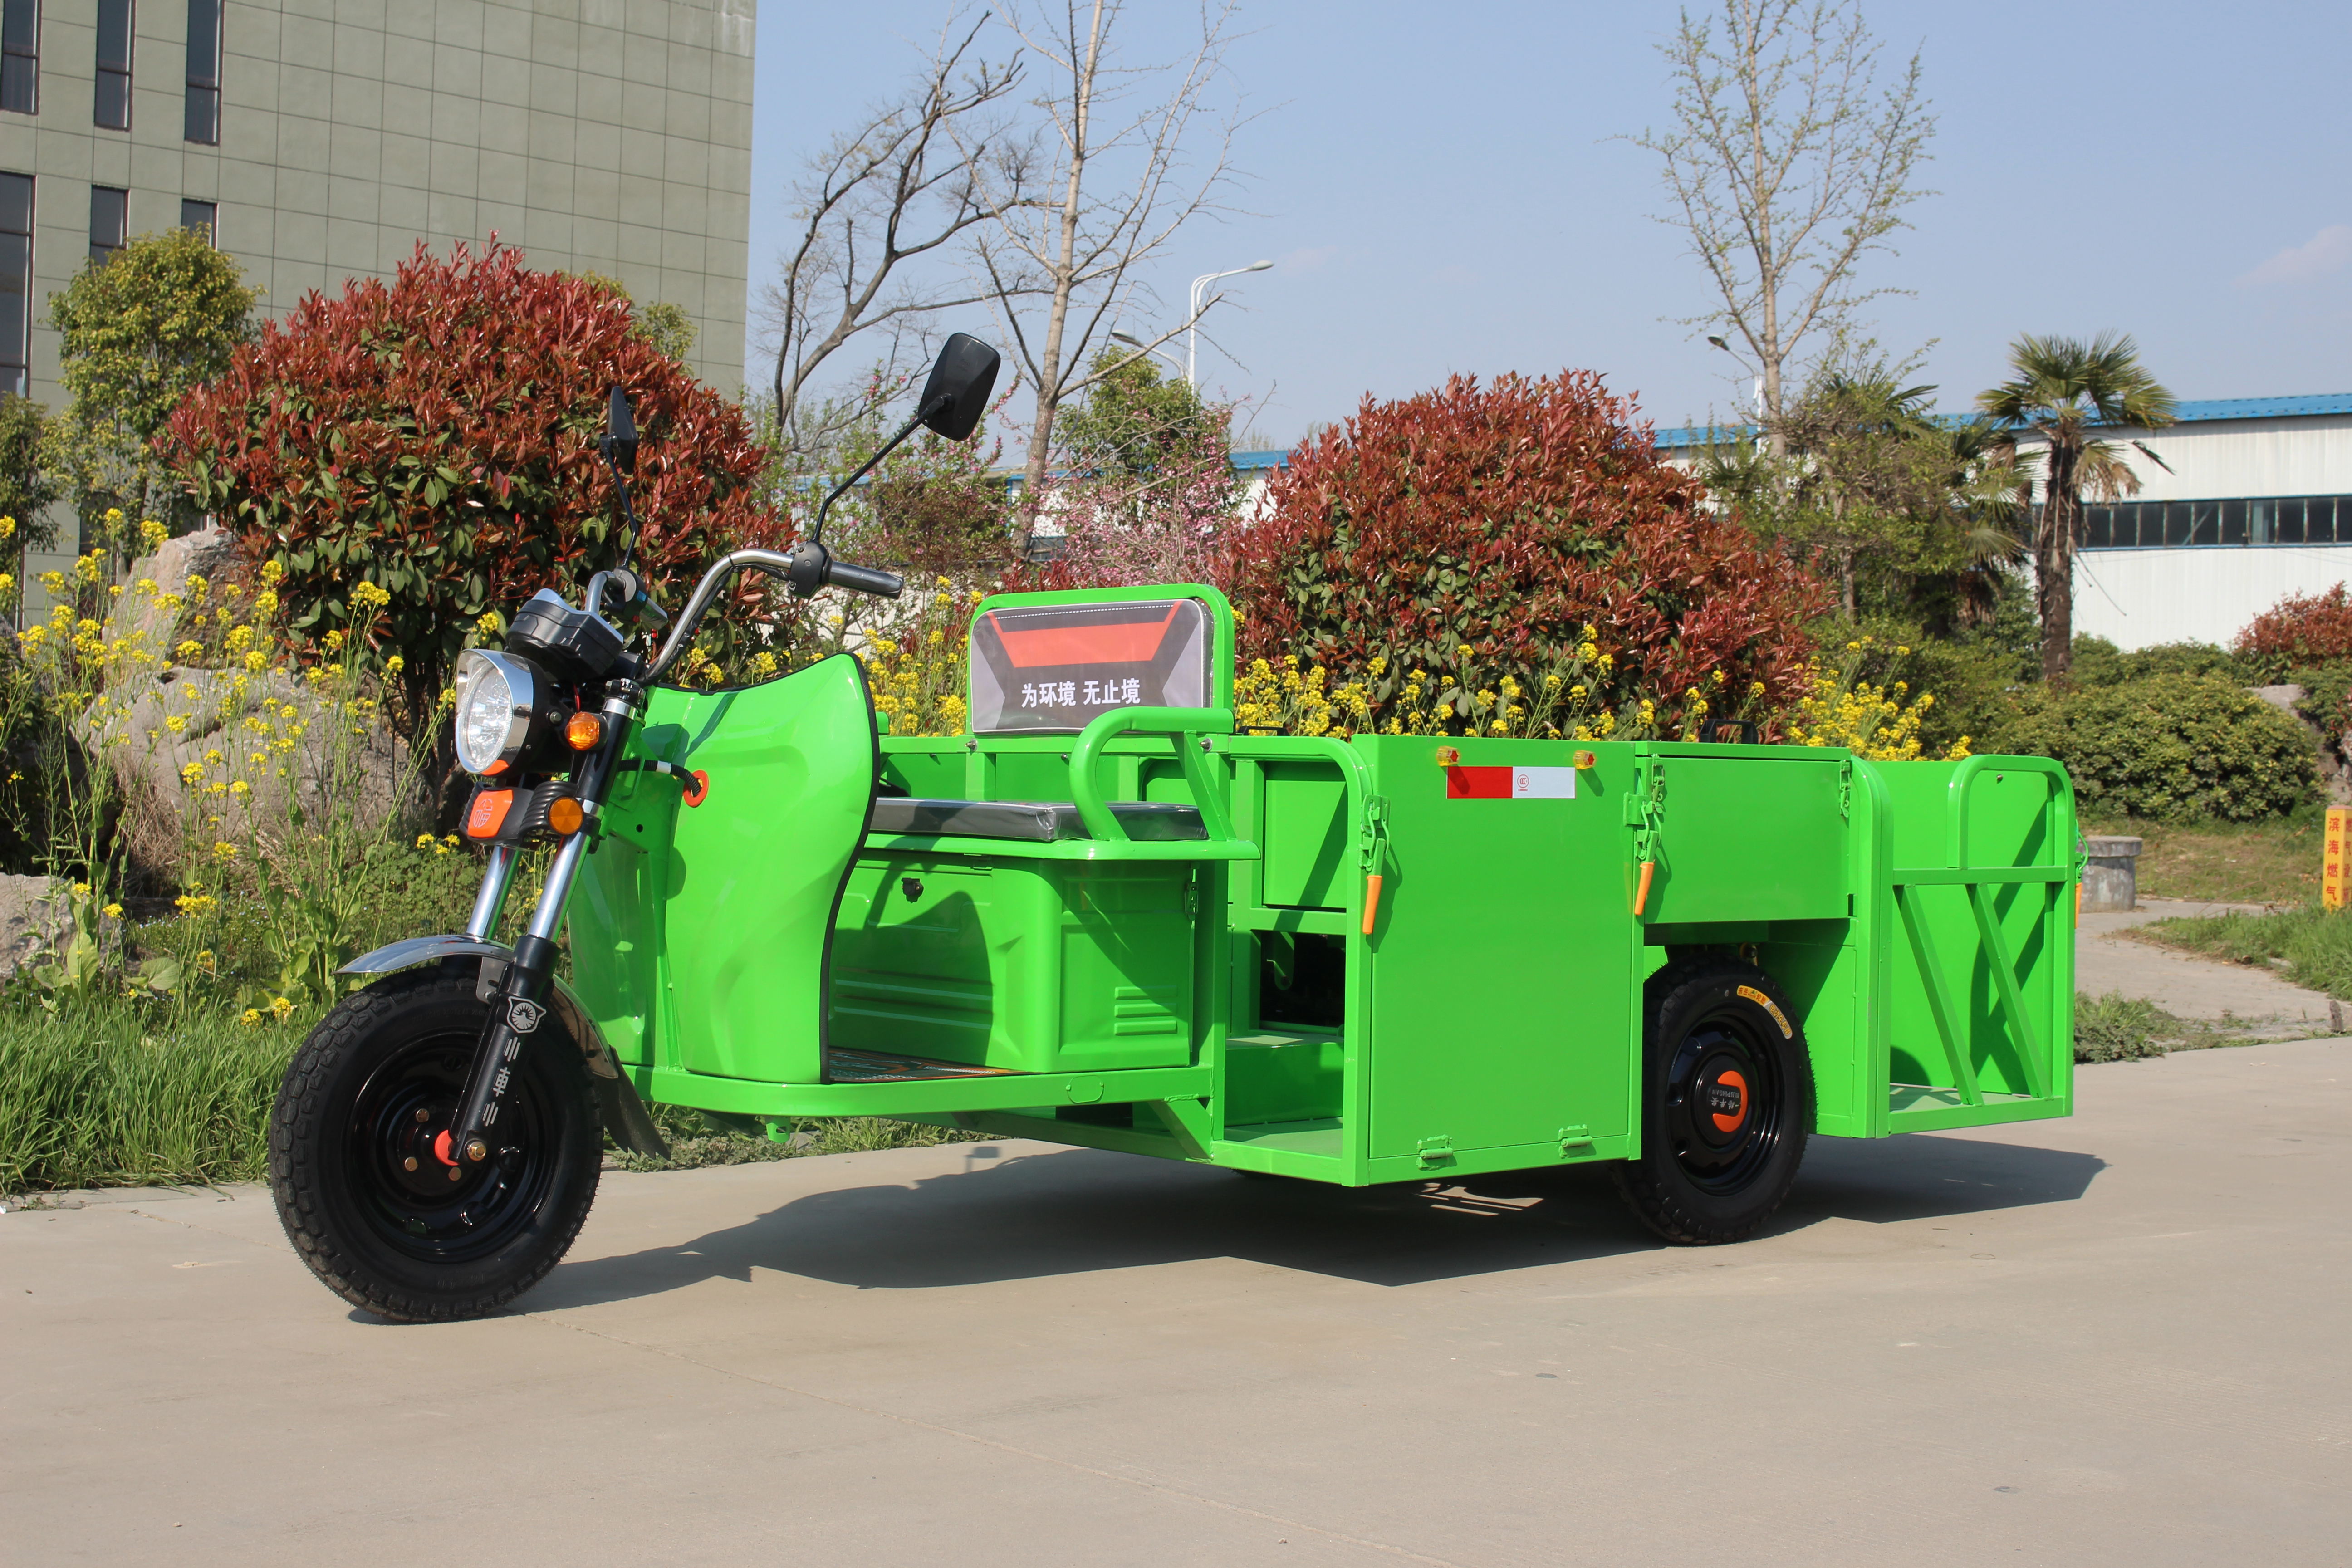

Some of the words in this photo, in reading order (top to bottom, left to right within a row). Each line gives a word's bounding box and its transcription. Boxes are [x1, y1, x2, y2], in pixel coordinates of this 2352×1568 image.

[1021, 681, 1076, 708] 为环境
[1083, 678, 1140, 705] 无止境
[2326, 818, 2340, 901] 滨海燃气
[1769, 1004, 1791, 1035] 电动车专用
